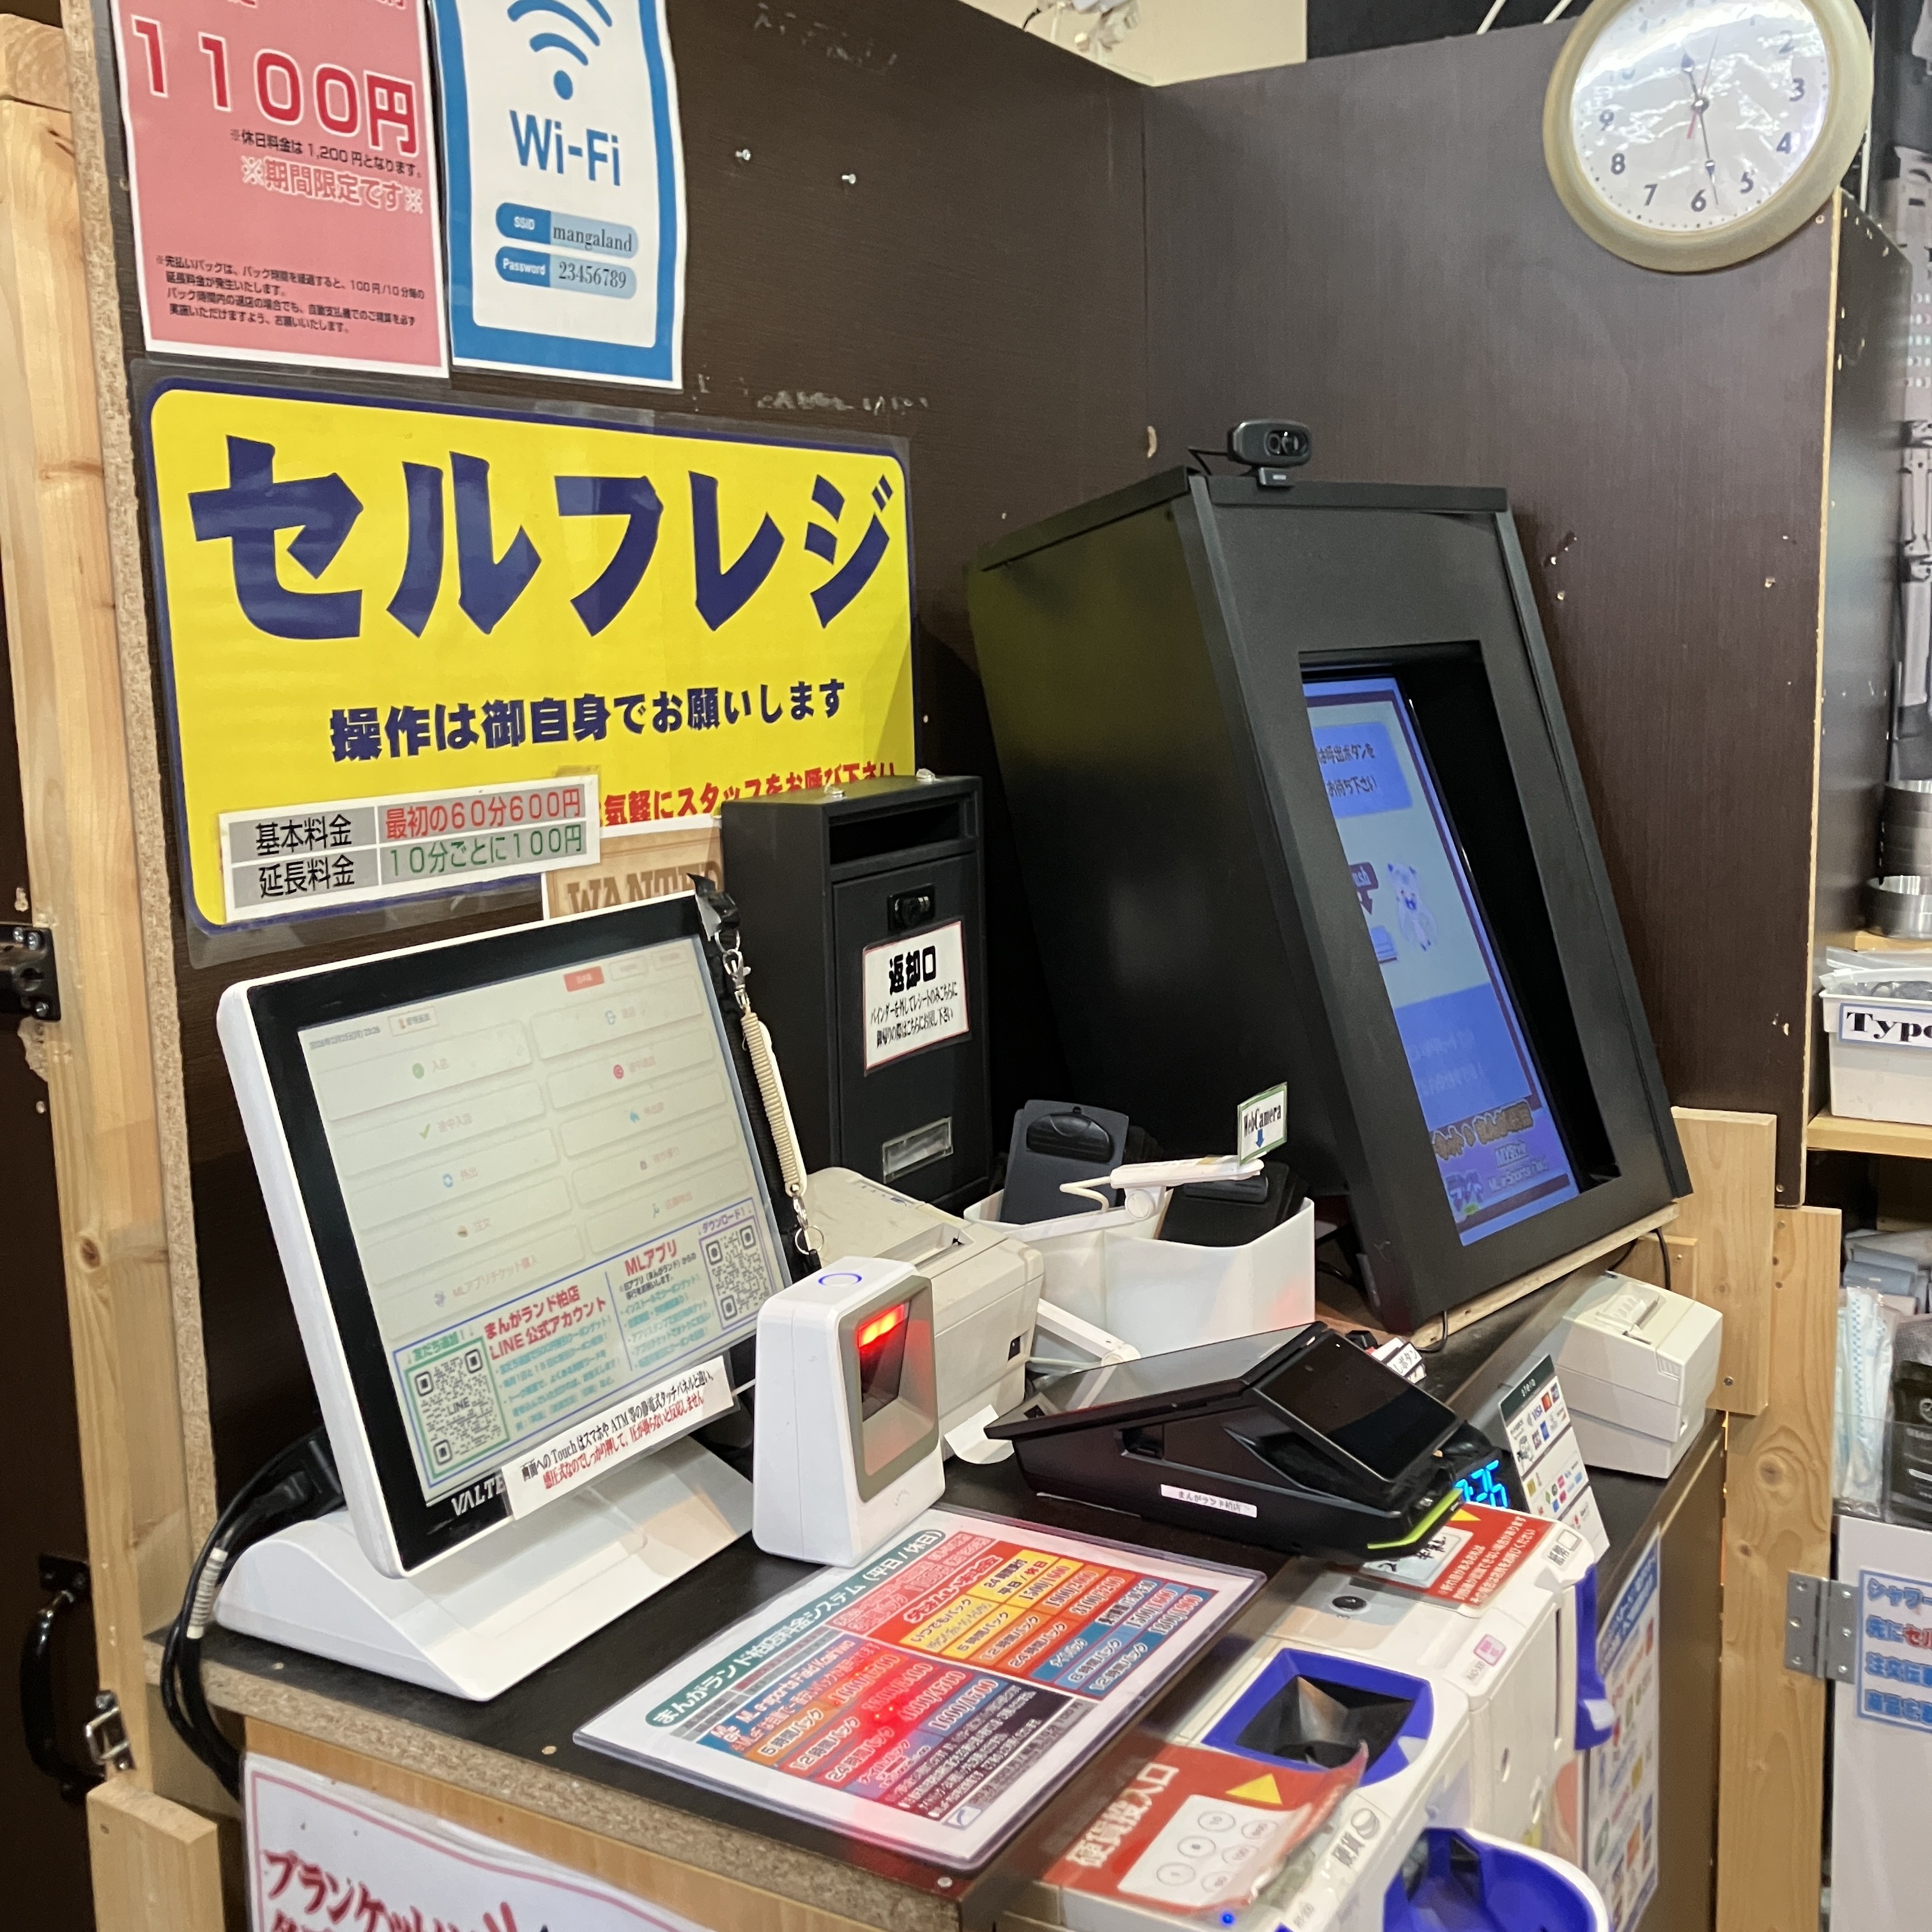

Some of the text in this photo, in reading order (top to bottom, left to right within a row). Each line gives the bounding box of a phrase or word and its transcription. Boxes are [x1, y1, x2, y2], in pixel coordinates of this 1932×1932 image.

[131, 14, 418, 157] 1100円
[1599, 109, 1614, 130] 9
[510, 109, 620, 187] Wi-Fi
[1611, 152, 1626, 175] 8
[1776, 132, 1792, 153] 4
[1644, 183, 1657, 206] 7
[1690, 189, 1706, 212] 6
[1740, 171, 1754, 194] 5
[514, 216, 632, 252] SSID mangaland
[503, 257, 626, 289] Password 23456789
[188, 434, 893, 638] セルフレジ
[330, 679, 846, 762] 操作は御自身でお願いします
[256, 787, 581, 856] 基本料金 最初の60分600円
[259, 824, 582, 898] 延長料金 10分ごとに100円
[889, 945, 936, 995] 返却口
[623, 1239, 677, 1276] MLアプリ
[484, 1285, 581, 1340] まんがランド柏店
[489, 1333, 525, 1361] LINE
[525, 1297, 606, 1346] 公式アカウント
[447, 1397, 470, 1416] LINE
[551, 1441, 578, 1463] Touch
[611, 1411, 629, 1435] ATM
